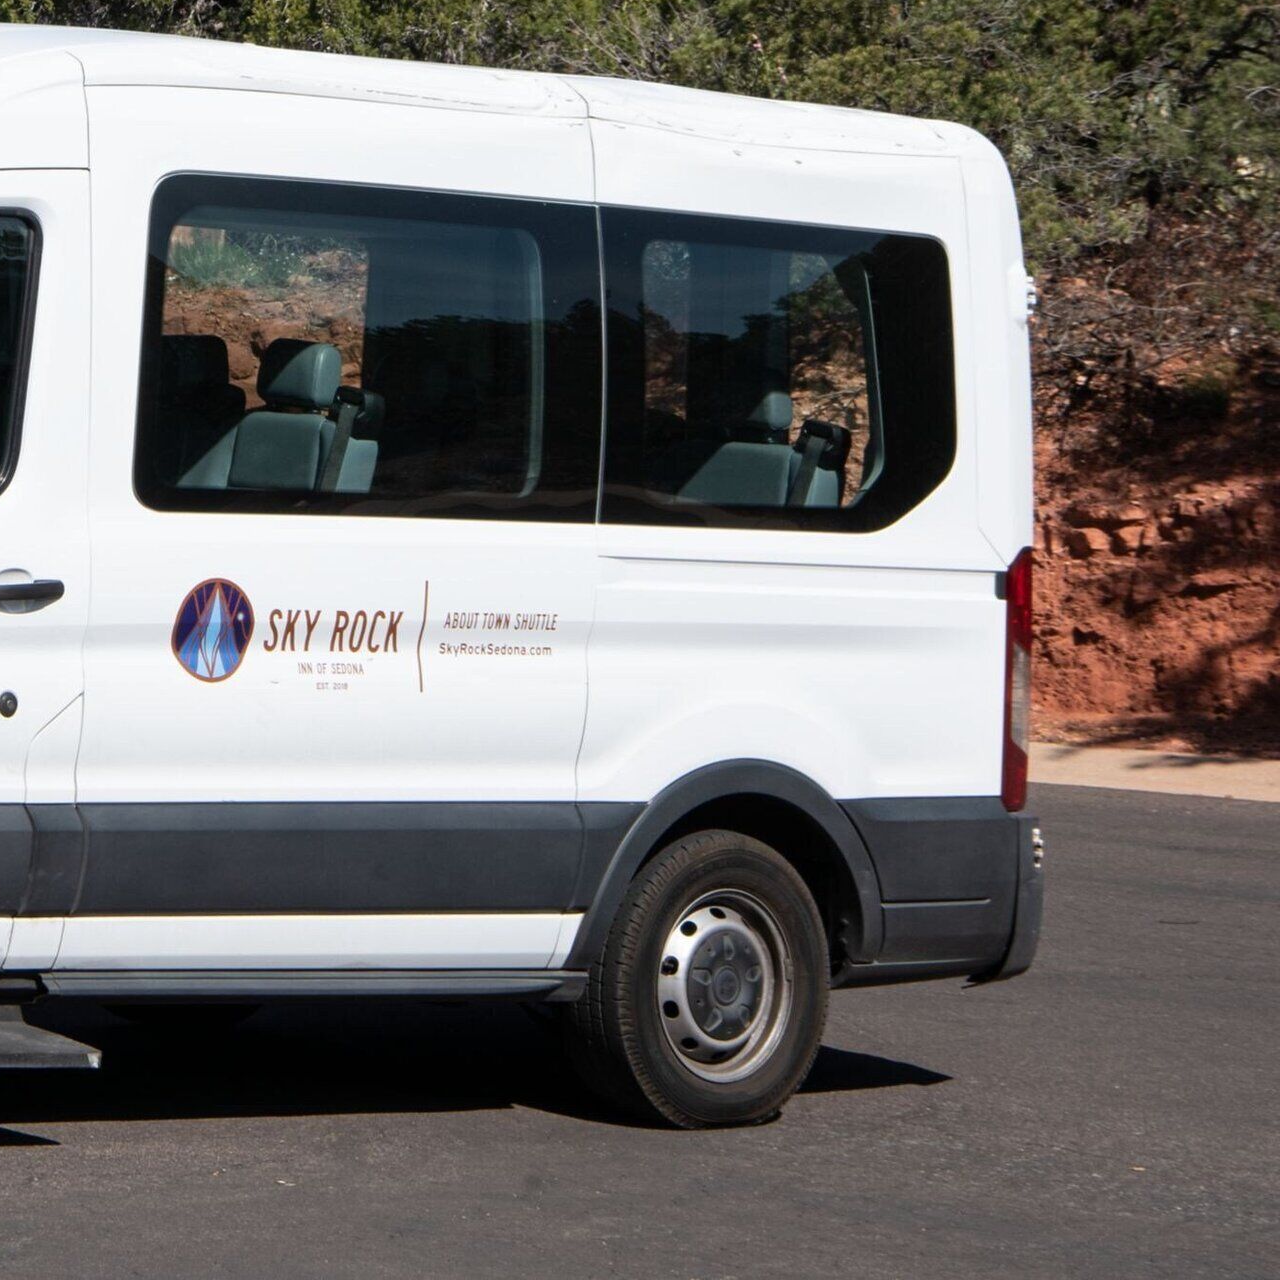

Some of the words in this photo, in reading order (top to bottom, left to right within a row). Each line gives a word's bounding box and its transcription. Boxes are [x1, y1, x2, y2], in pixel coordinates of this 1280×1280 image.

[443, 612, 481, 629] ABOUT
[482, 612, 511, 630] TOWN
[513, 613, 558, 631] SHUTTLE
[263, 608, 322, 652] SKY
[329, 609, 404, 653] ROCK
[439, 642, 552, 657] SkyRockSedona.com
[297, 662, 313, 675] INN
[316, 662, 328, 675] OF
[331, 662, 365, 675] SEDONA
